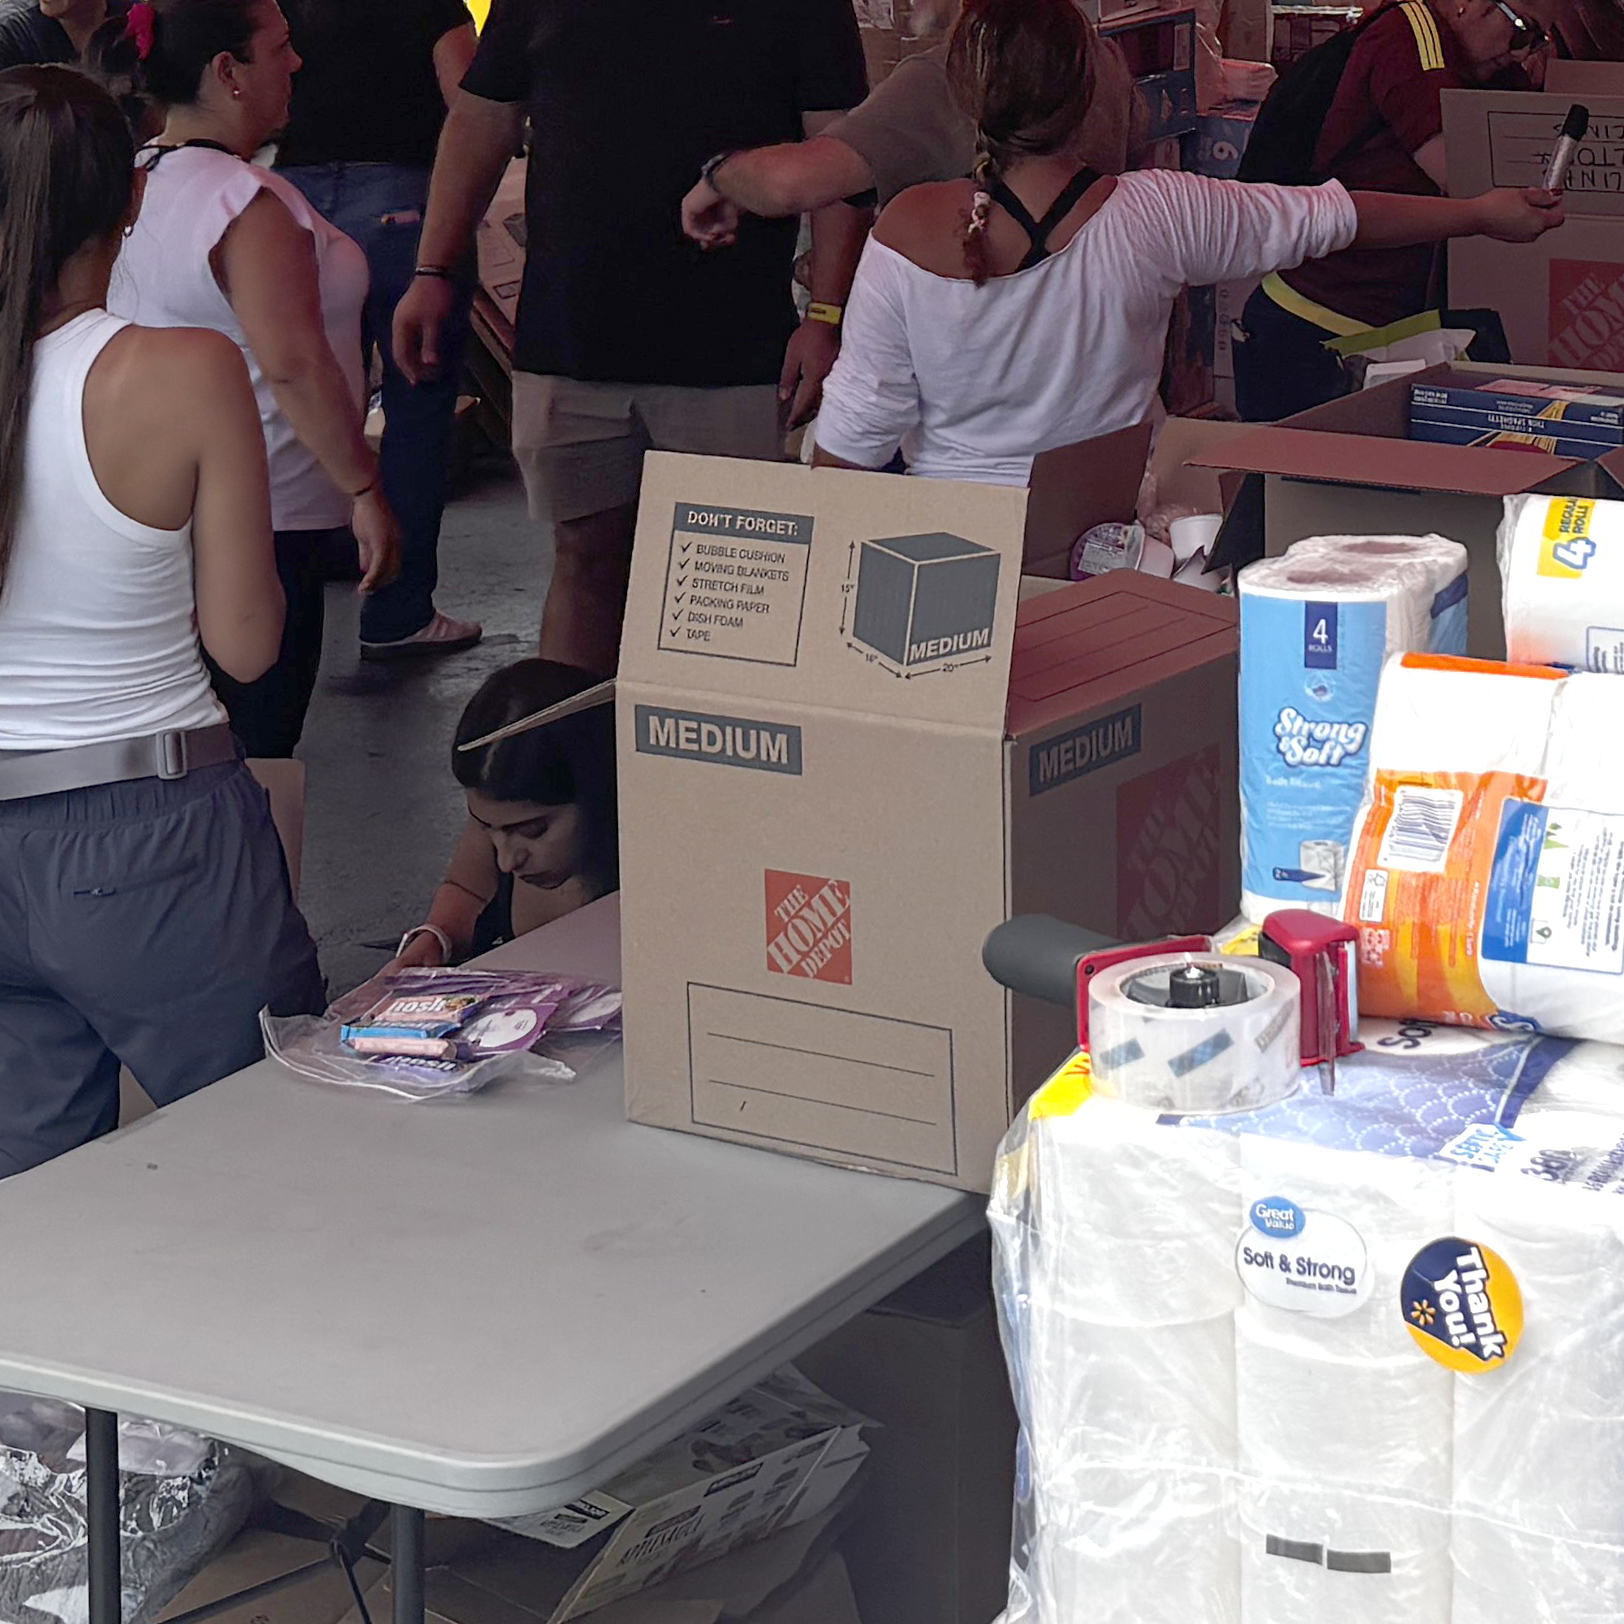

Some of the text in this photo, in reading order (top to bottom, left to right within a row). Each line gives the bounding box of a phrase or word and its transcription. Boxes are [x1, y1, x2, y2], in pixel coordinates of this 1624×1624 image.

[687, 510, 799, 536] DON'T FORGET:
[1559, 497, 1576, 534] REGULA
[696, 544, 786, 563] BUBBLE CUSHION
[1554, 536, 1596, 570] 4
[691, 578, 765, 596] STRETCH FILM
[694, 561, 790, 581] MOVING BLANKETS
[687, 611, 744, 629] DISH FOAM
[689, 594, 770, 615] PACKING PAPER
[685, 627, 711, 642] TAPE
[909, 628, 990, 662] MEDIUM
[1312, 618, 1329, 644] 4
[648, 715, 790, 766] MEDIUM
[1275, 707, 1368, 754] Strong
[1038, 714, 1135, 782] MEDIUM
[1285, 735, 1347, 767] Soft
[774, 884, 809, 923] THE
[767, 879, 851, 975] HOME
[799, 917, 852, 979] DEPOT
[1256, 1203, 1294, 1222] Great
[1265, 1217, 1296, 1231] Value
[1243, 1246, 1356, 1286] Soft & Strong
[1434, 1268, 1475, 1350] You!
[1456, 1245, 1508, 1360] Thank
